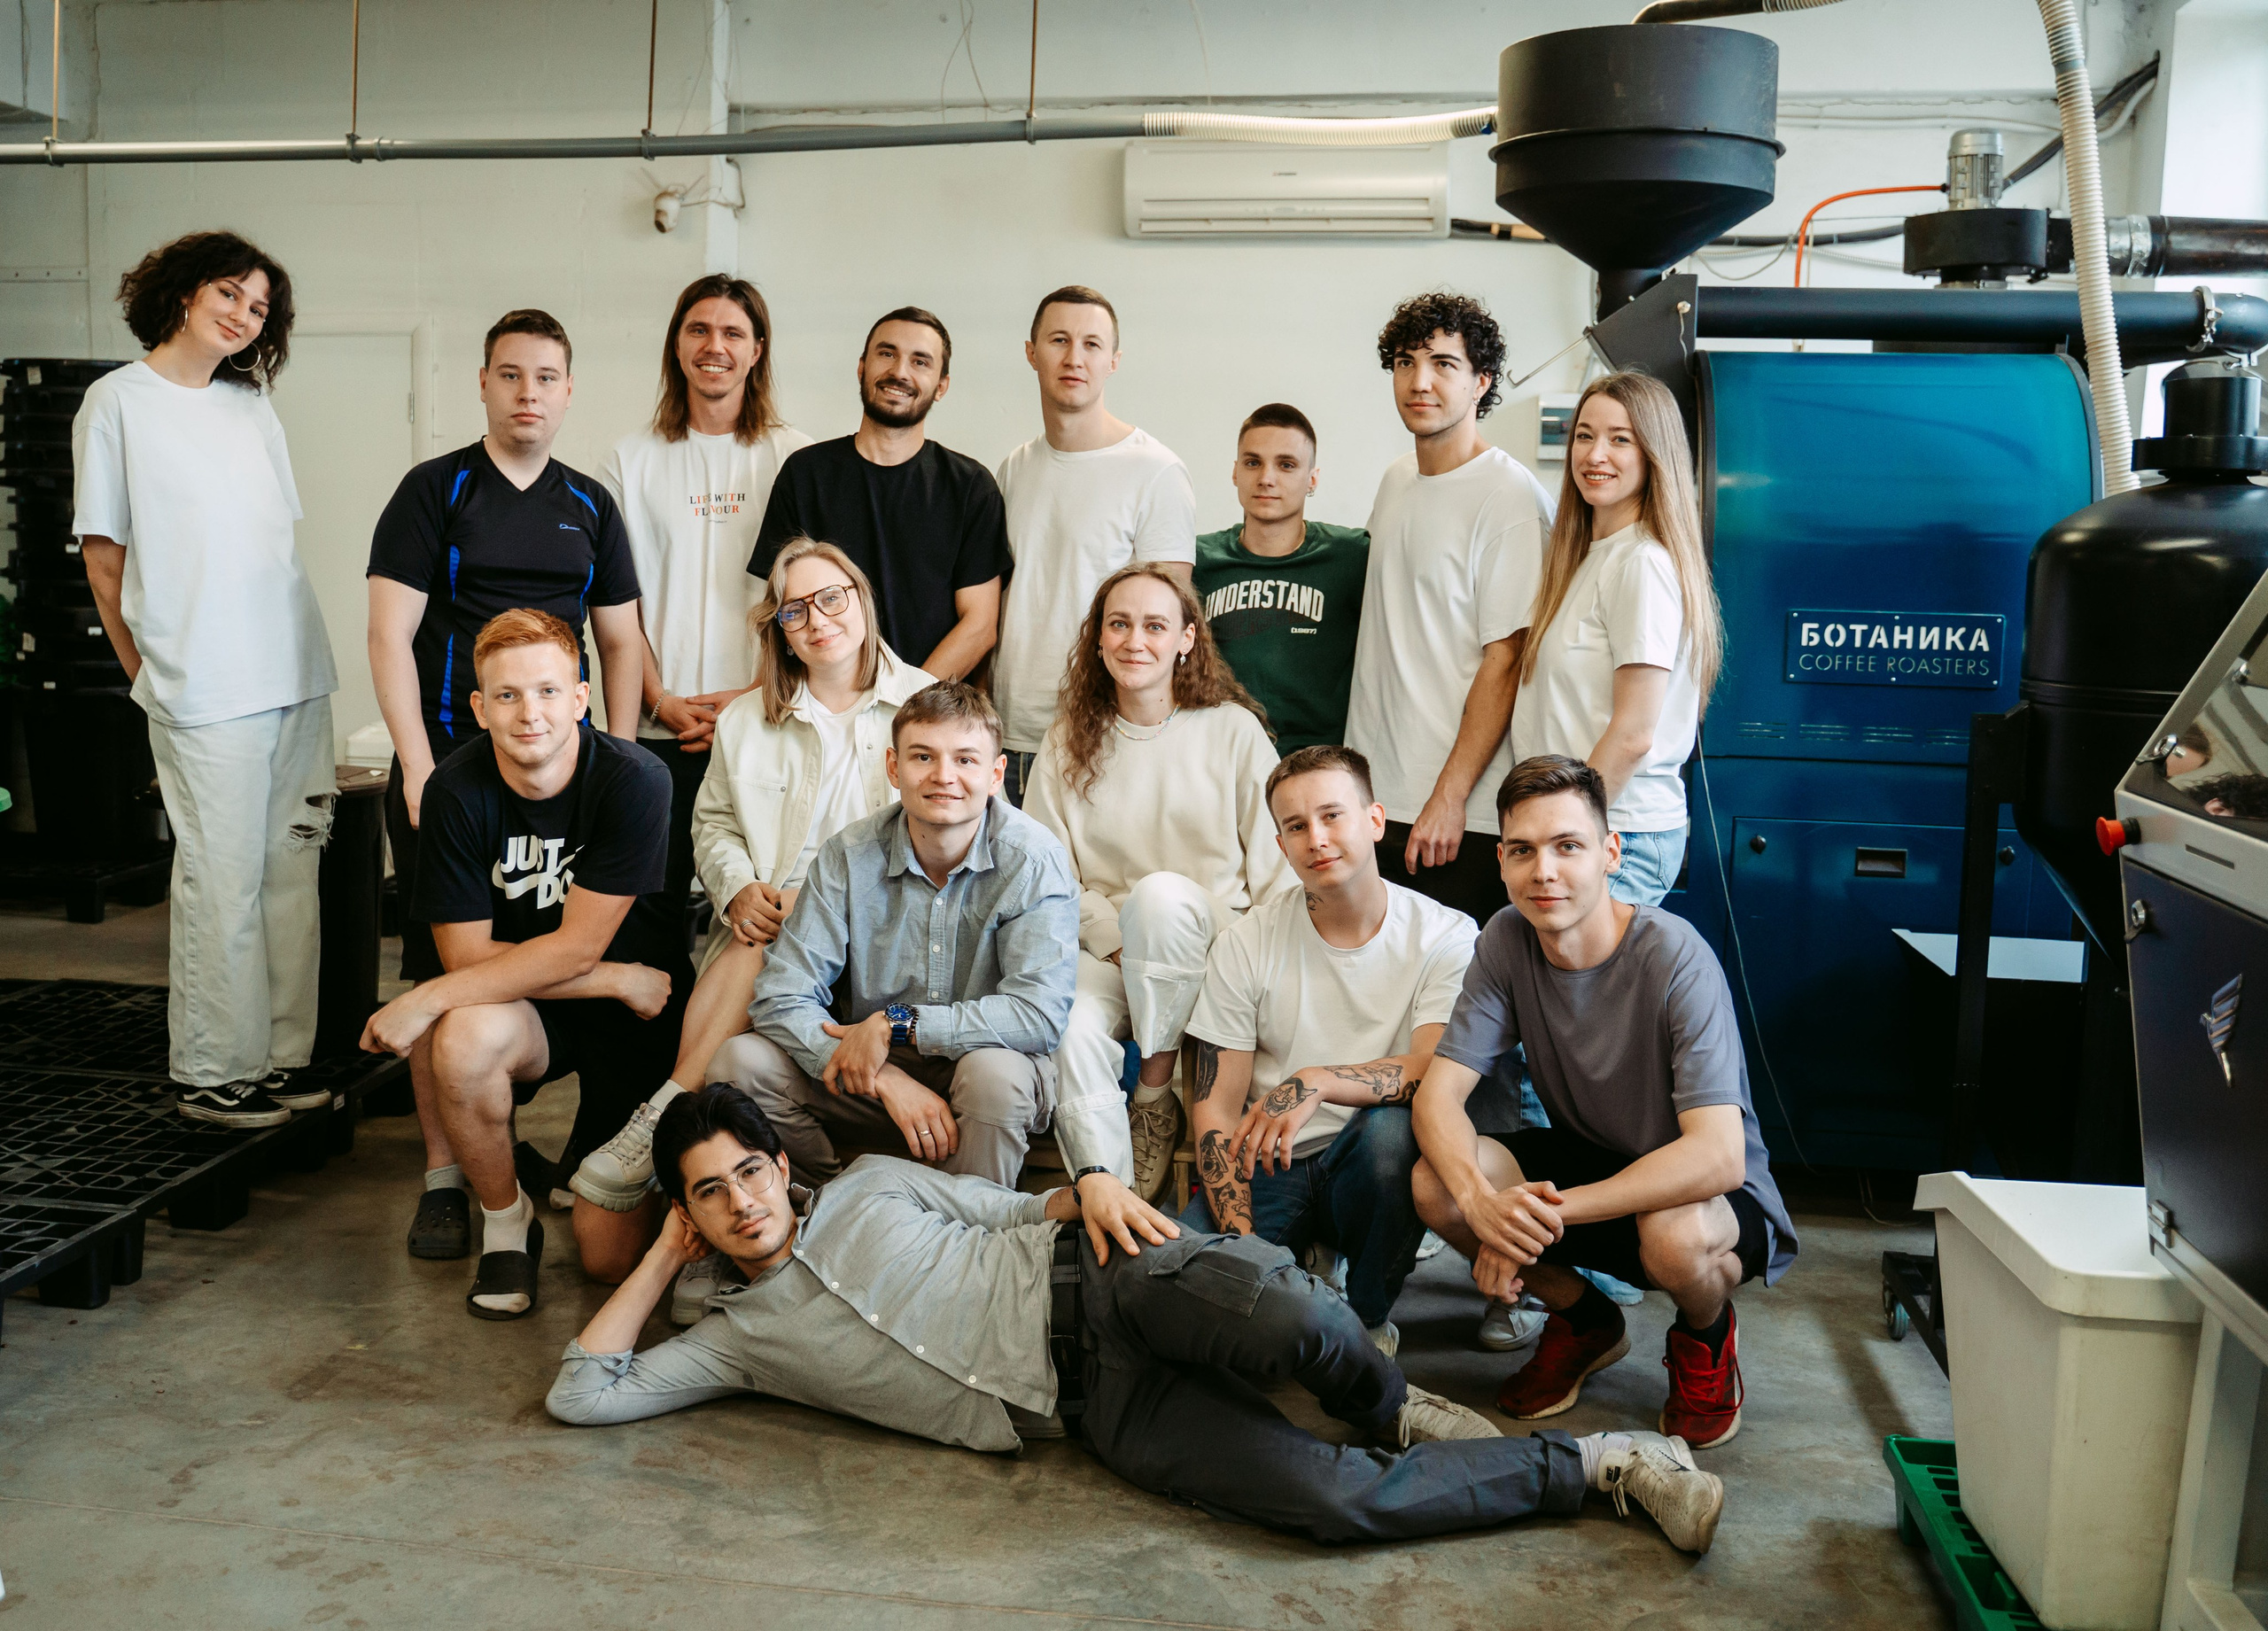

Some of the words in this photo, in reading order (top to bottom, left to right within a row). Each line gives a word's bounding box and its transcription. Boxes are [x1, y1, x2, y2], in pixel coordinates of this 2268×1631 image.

[694, 505, 740, 516] FLVOUR
[714, 493, 746, 503] WITH
[1205, 579, 1325, 623] UNDERSTAND
[1800, 622, 1991, 652] БОТАНИКА
[1798, 654, 1877, 672] COFFEE
[1886, 656, 1991, 676] ROASTERS
[500, 835, 565, 874] JUST
